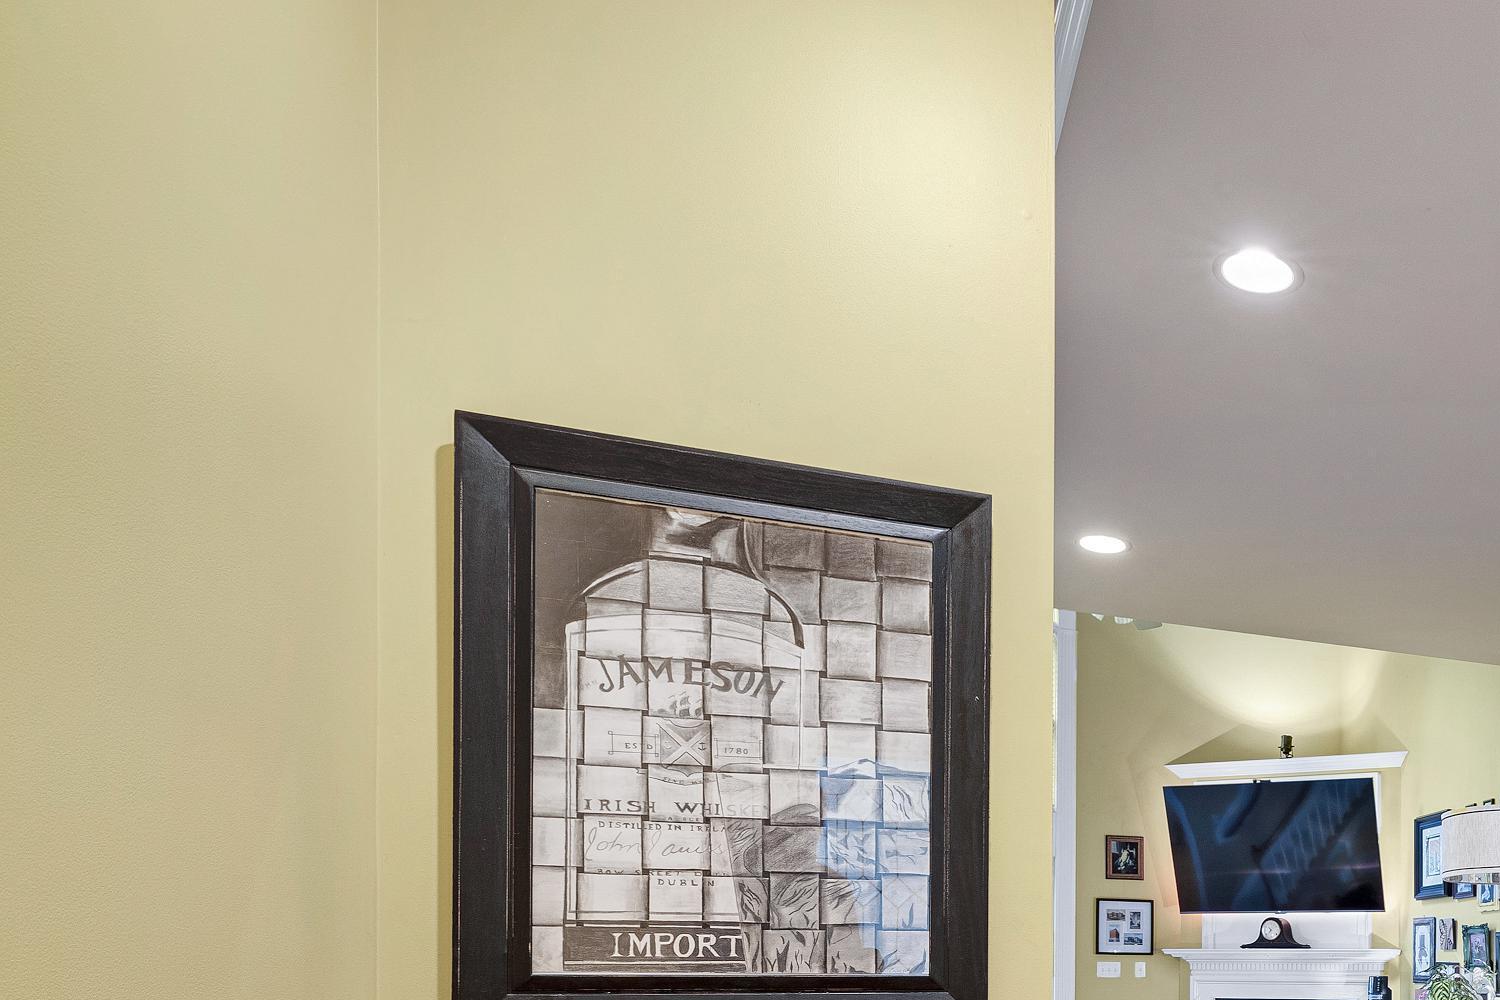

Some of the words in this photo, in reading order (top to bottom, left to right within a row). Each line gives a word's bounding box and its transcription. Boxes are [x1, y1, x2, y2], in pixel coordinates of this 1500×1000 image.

[597, 654, 785, 702] JAMESON
[724, 747, 749, 755] 1780
[583, 799, 656, 813] IRISH
[598, 821, 662, 831] DISTILLED
[610, 932, 743, 958] IMPORT
